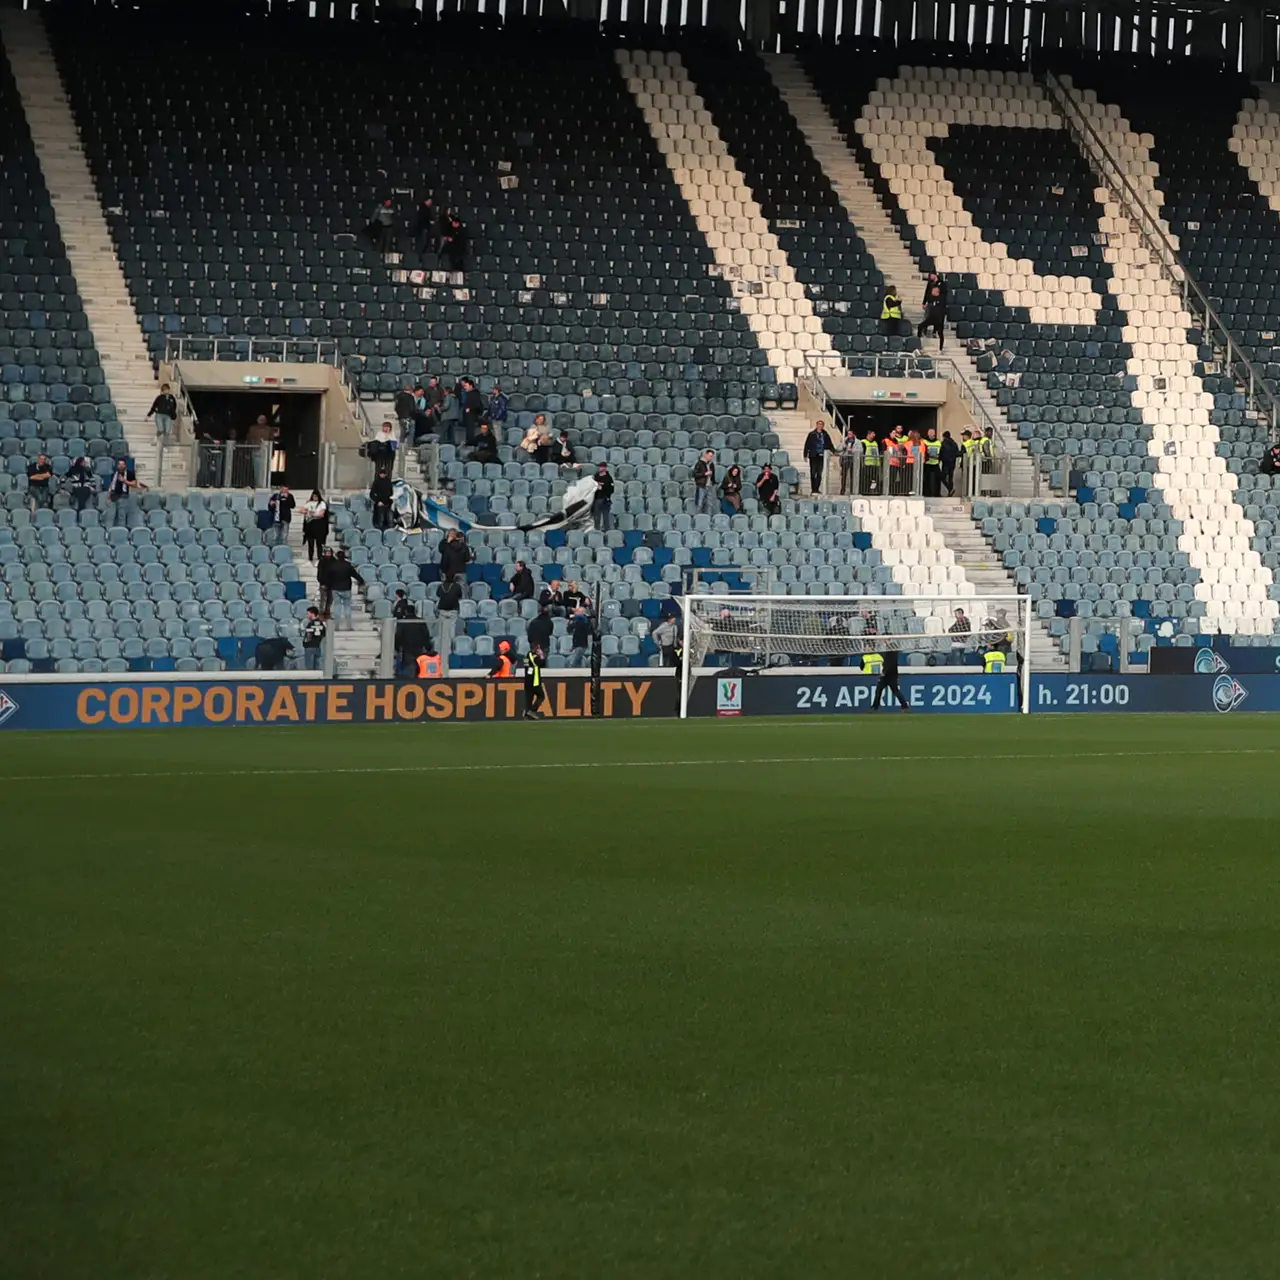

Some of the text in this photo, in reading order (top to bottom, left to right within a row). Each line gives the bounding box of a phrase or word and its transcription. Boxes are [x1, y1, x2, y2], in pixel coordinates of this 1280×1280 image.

[76, 684, 353, 724] CORPORATE
[796, 686, 828, 708] 24
[932, 684, 992, 706] 2024
[1038, 684, 1058, 705] h.
[1065, 684, 1130, 705] 21:00
